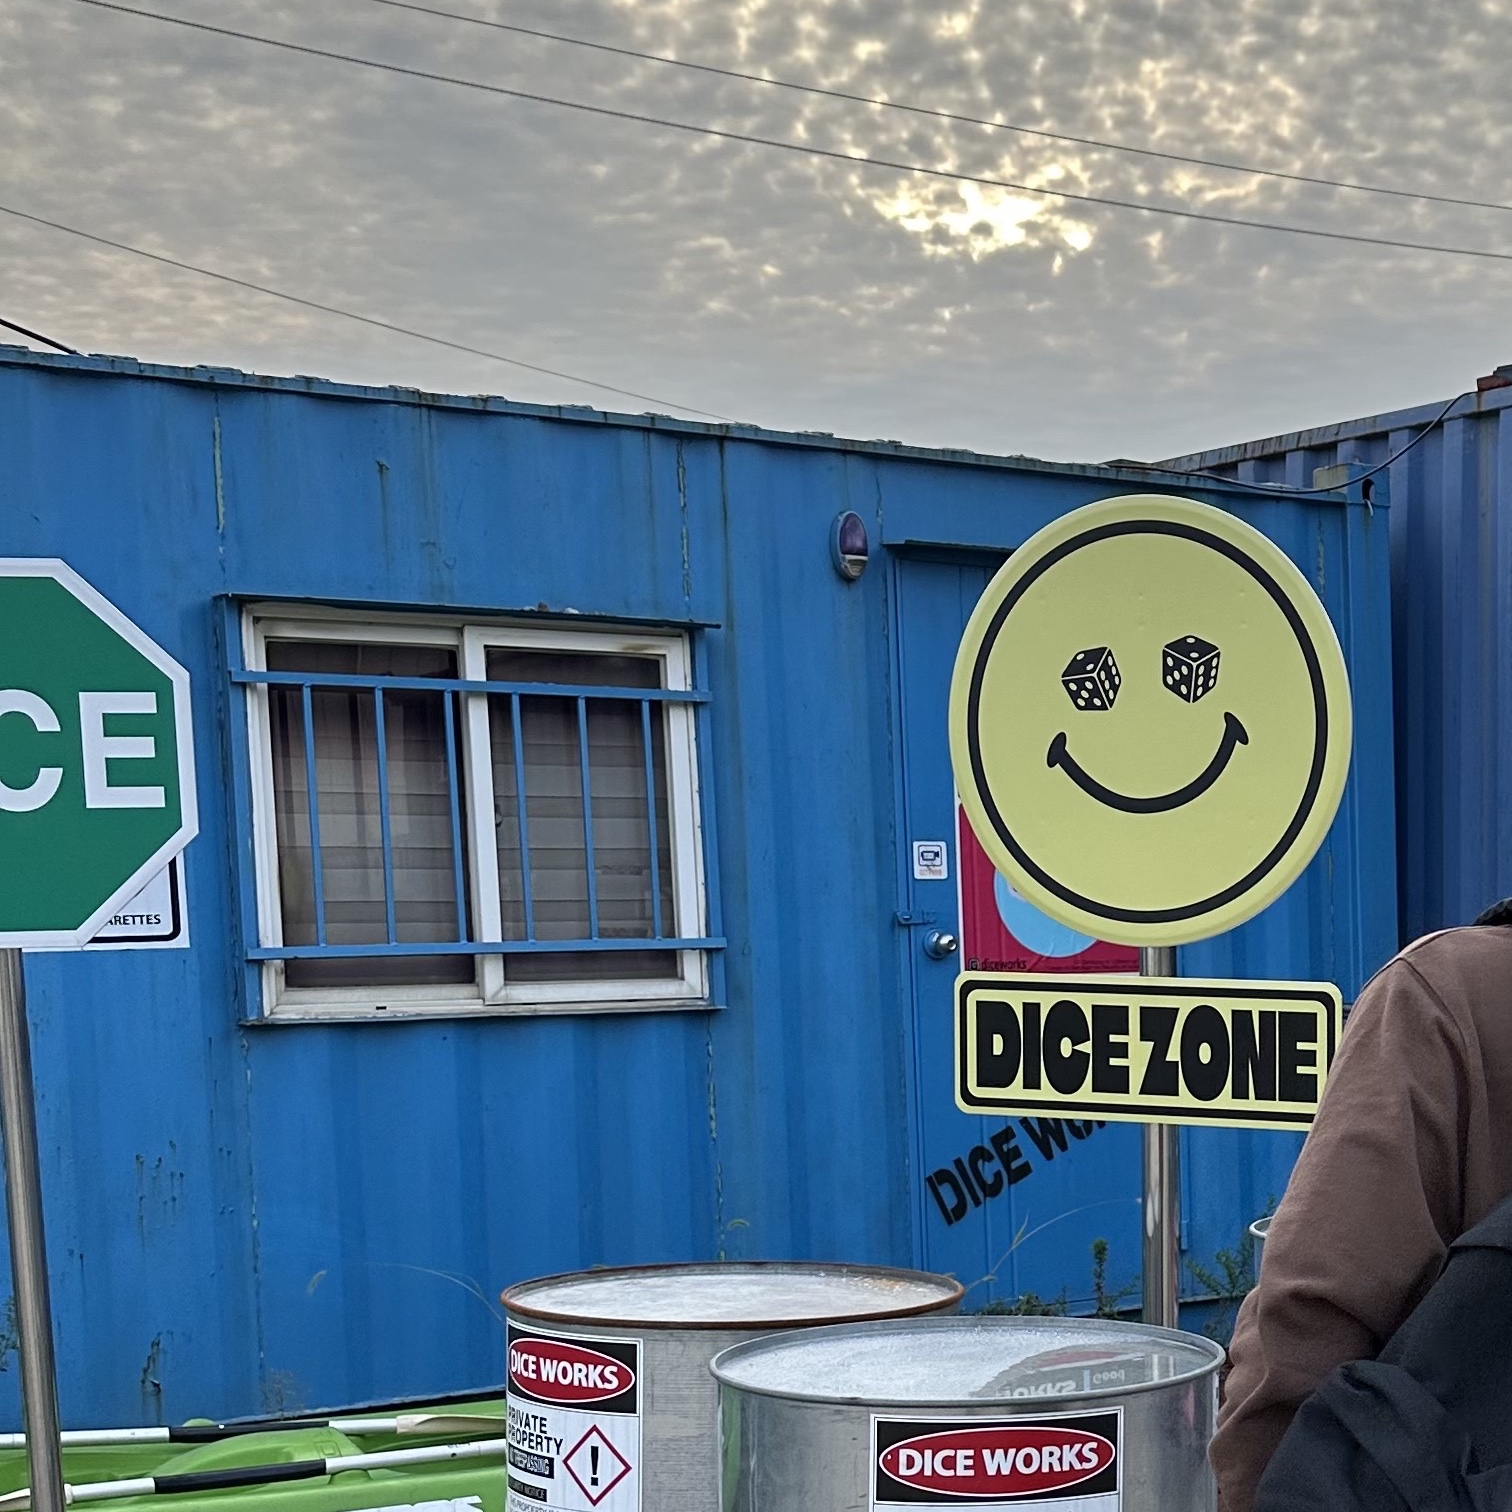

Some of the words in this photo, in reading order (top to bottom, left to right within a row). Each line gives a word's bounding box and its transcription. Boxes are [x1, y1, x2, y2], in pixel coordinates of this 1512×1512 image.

[976, 1000, 1130, 1095] DICE
[1139, 1004, 1318, 1103] ZONE
[926, 1126, 1033, 1225] DICE
[510, 1348, 537, 1380] DICE
[540, 1357, 619, 1390] WORKS
[898, 1448, 975, 1477] DICE
[982, 1441, 1100, 1476] WORKS
